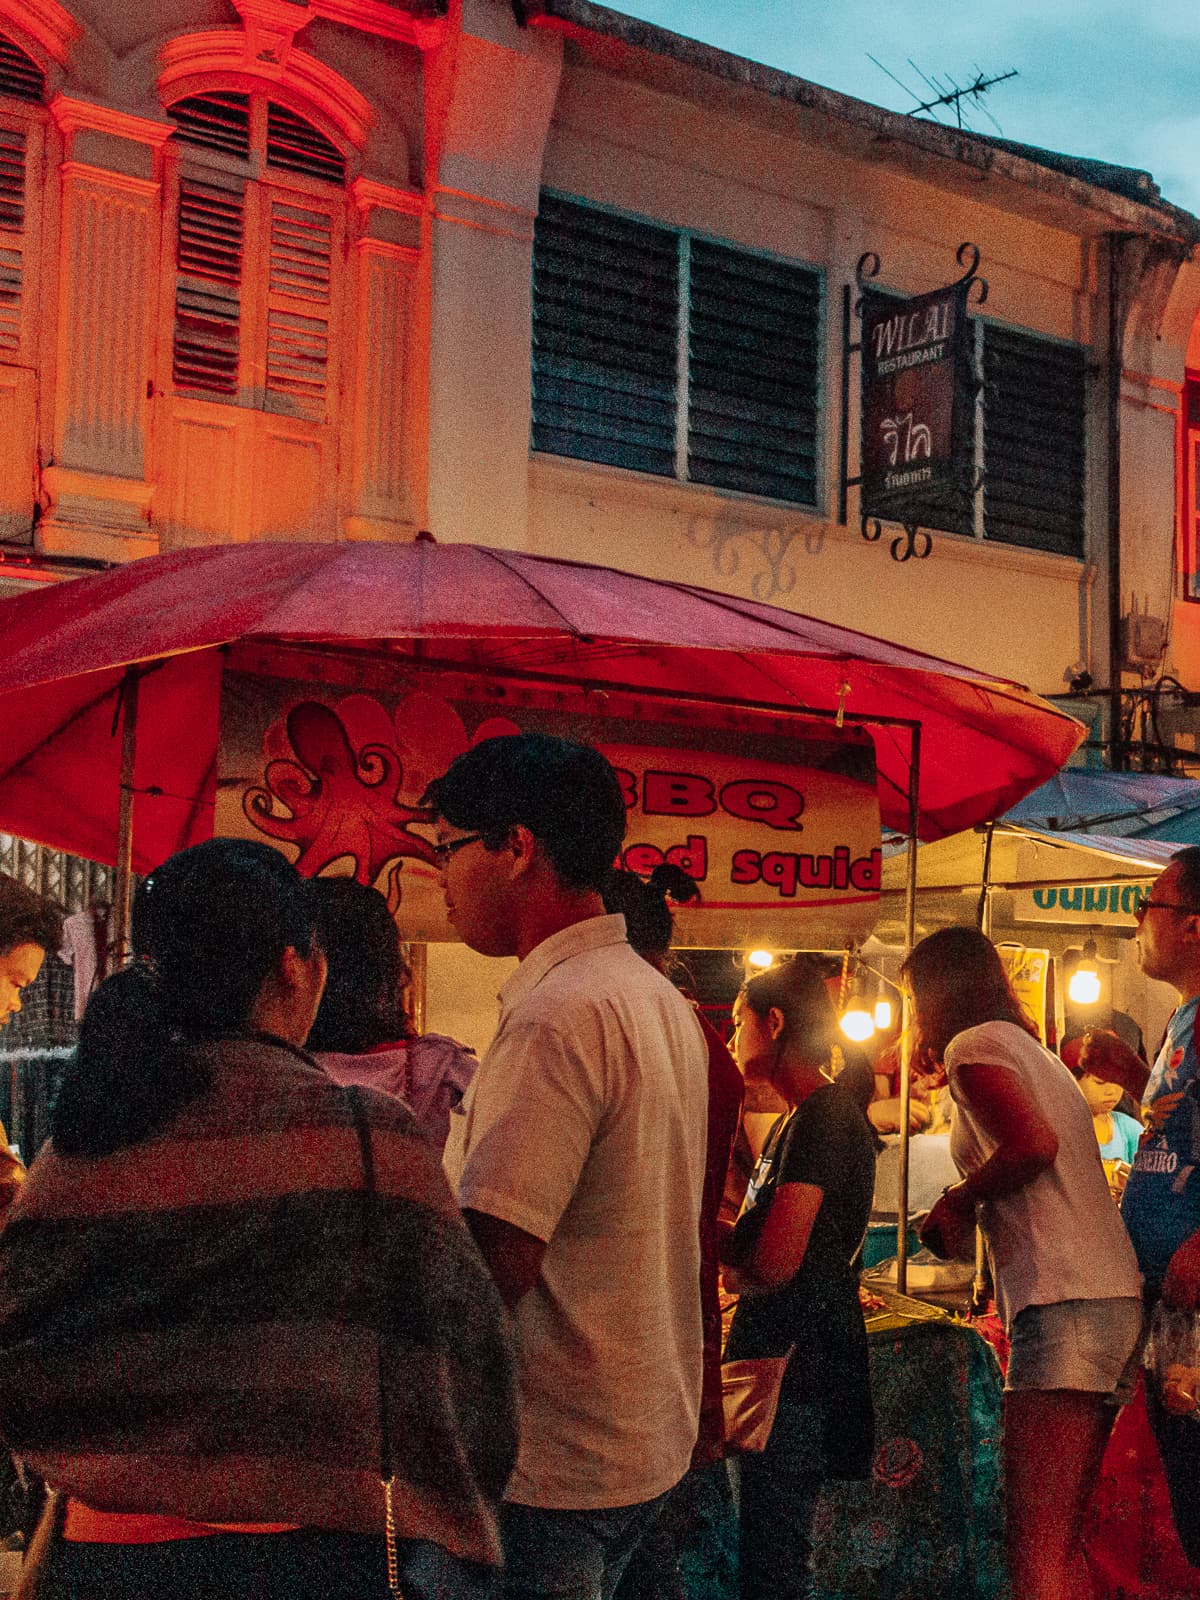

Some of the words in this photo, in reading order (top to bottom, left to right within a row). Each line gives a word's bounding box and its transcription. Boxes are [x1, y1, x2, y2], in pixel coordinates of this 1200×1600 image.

[873, 304, 949, 357] WILAI
[878, 344, 944, 376] RESTAURANT
[731, 846, 881, 897] squid
